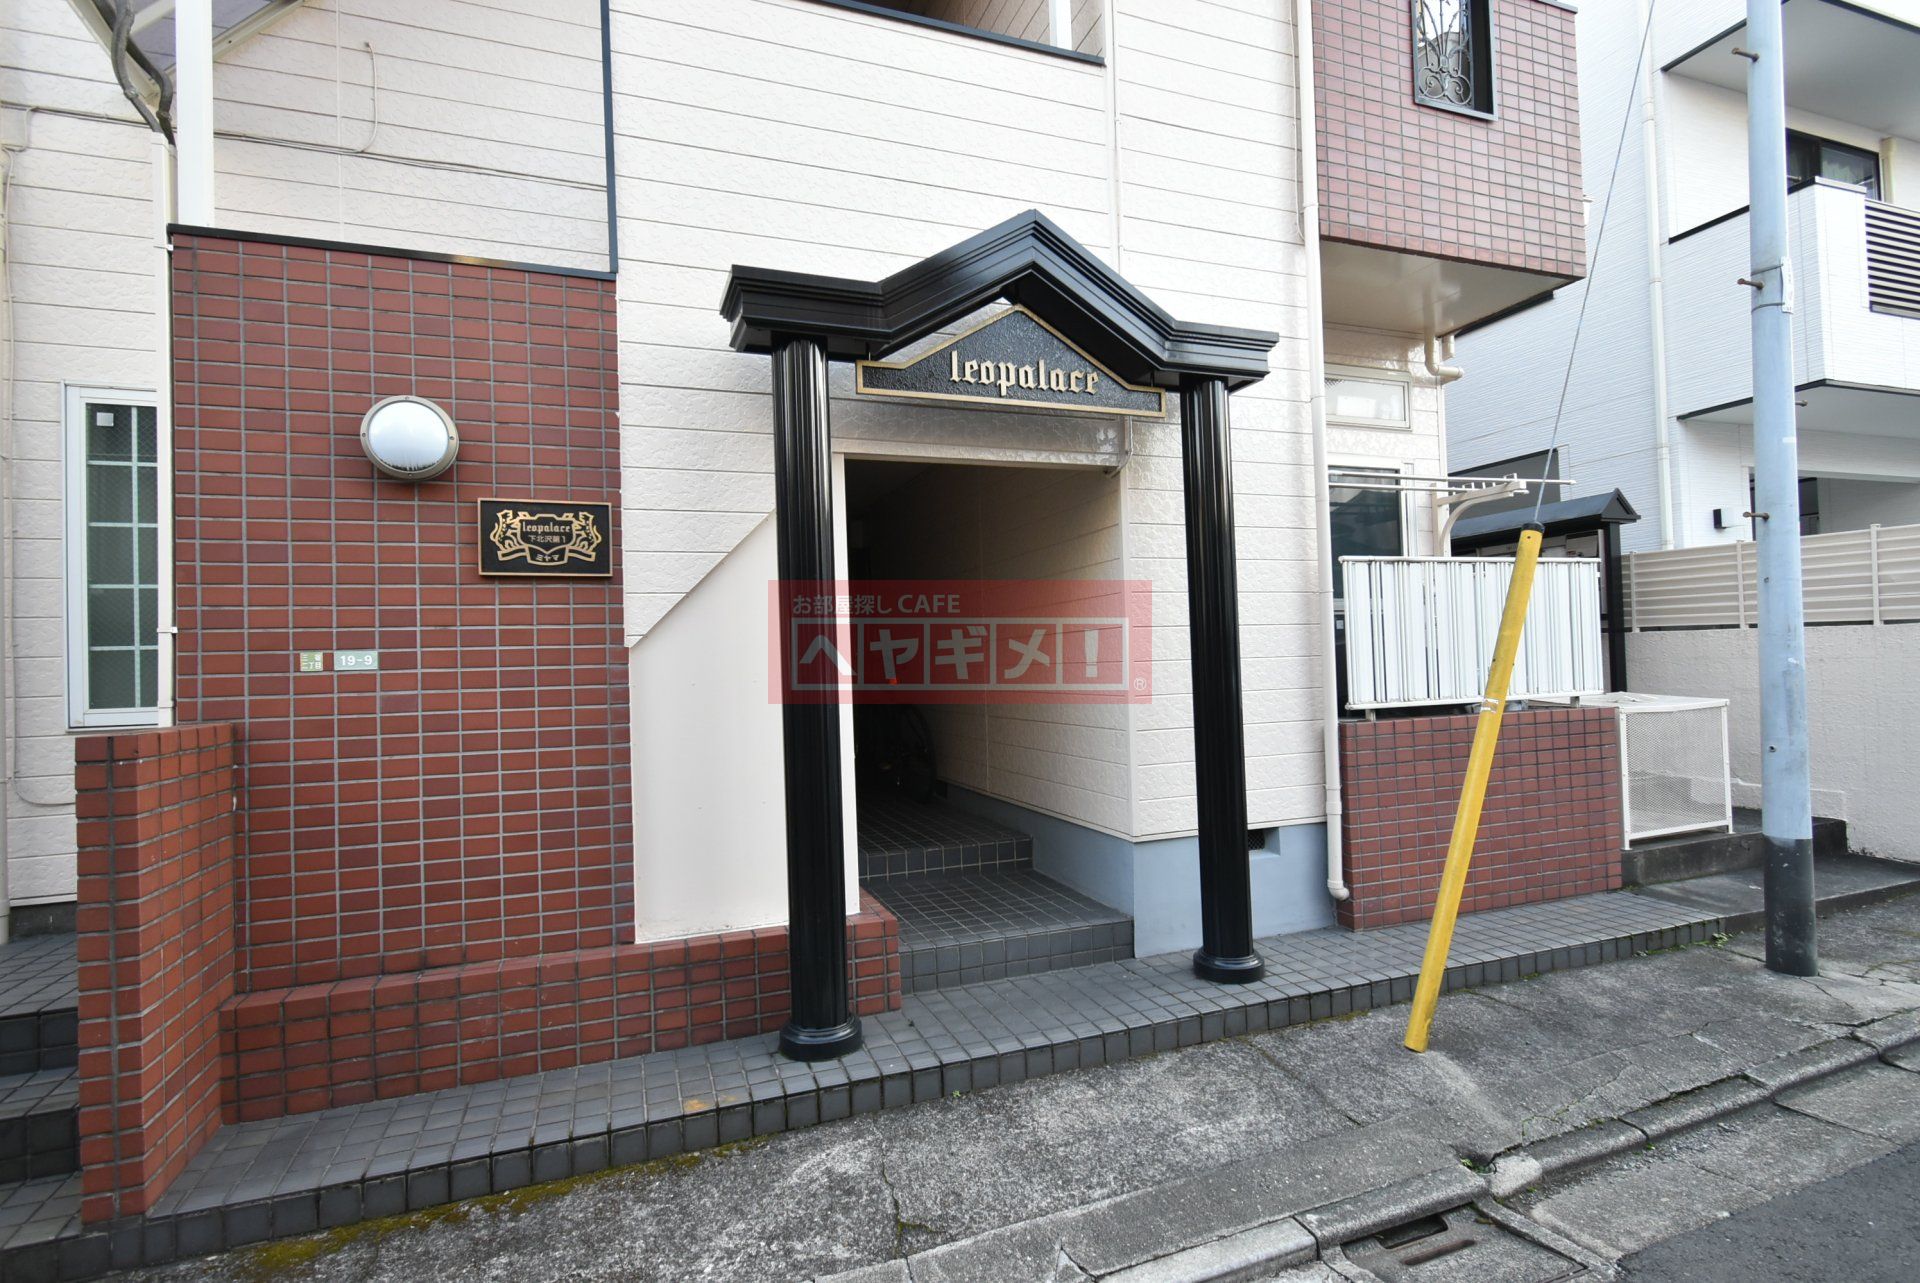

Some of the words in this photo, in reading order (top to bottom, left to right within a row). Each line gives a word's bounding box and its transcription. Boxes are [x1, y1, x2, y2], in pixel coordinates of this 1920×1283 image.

[950, 349, 1099, 397] leopalace
[522, 521, 571, 534] leopalace
[340, 655, 373, 666] 19-9
